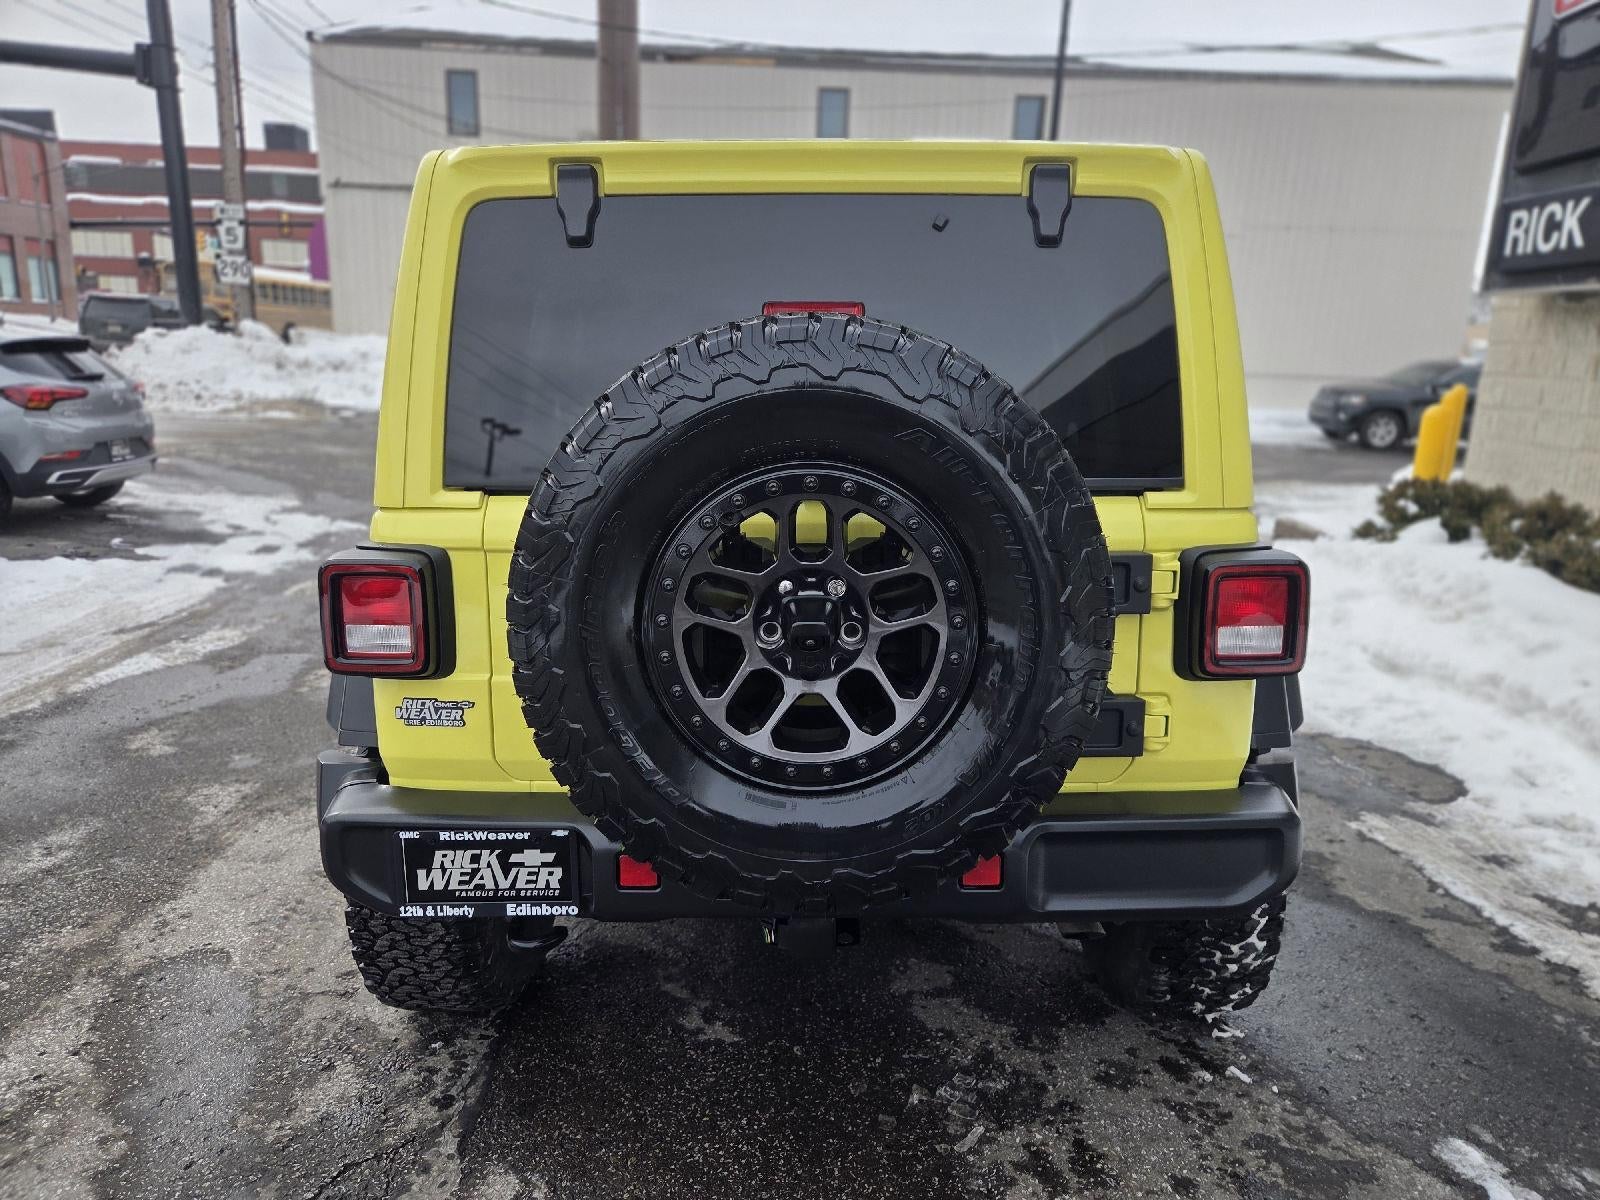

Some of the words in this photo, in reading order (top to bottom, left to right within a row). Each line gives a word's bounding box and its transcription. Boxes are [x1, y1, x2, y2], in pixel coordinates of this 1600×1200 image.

[1504, 197, 1592, 257] RICK
[224, 227, 239, 245] 5
[219, 260, 252, 278] 290
[401, 698, 437, 709] RICK
[395, 708, 463, 720] WEAVER
[399, 831, 420, 839] GMC
[439, 830, 531, 841] RickWeaver
[431, 849, 502, 869] RICK
[416, 867, 563, 891] WEAVER
[520, 889, 560, 897] SERVICE
[399, 905, 424, 917] 12th
[425, 905, 435, 917] &
[437, 904, 475, 919] Liberty
[506, 903, 579, 916] Edinboro
